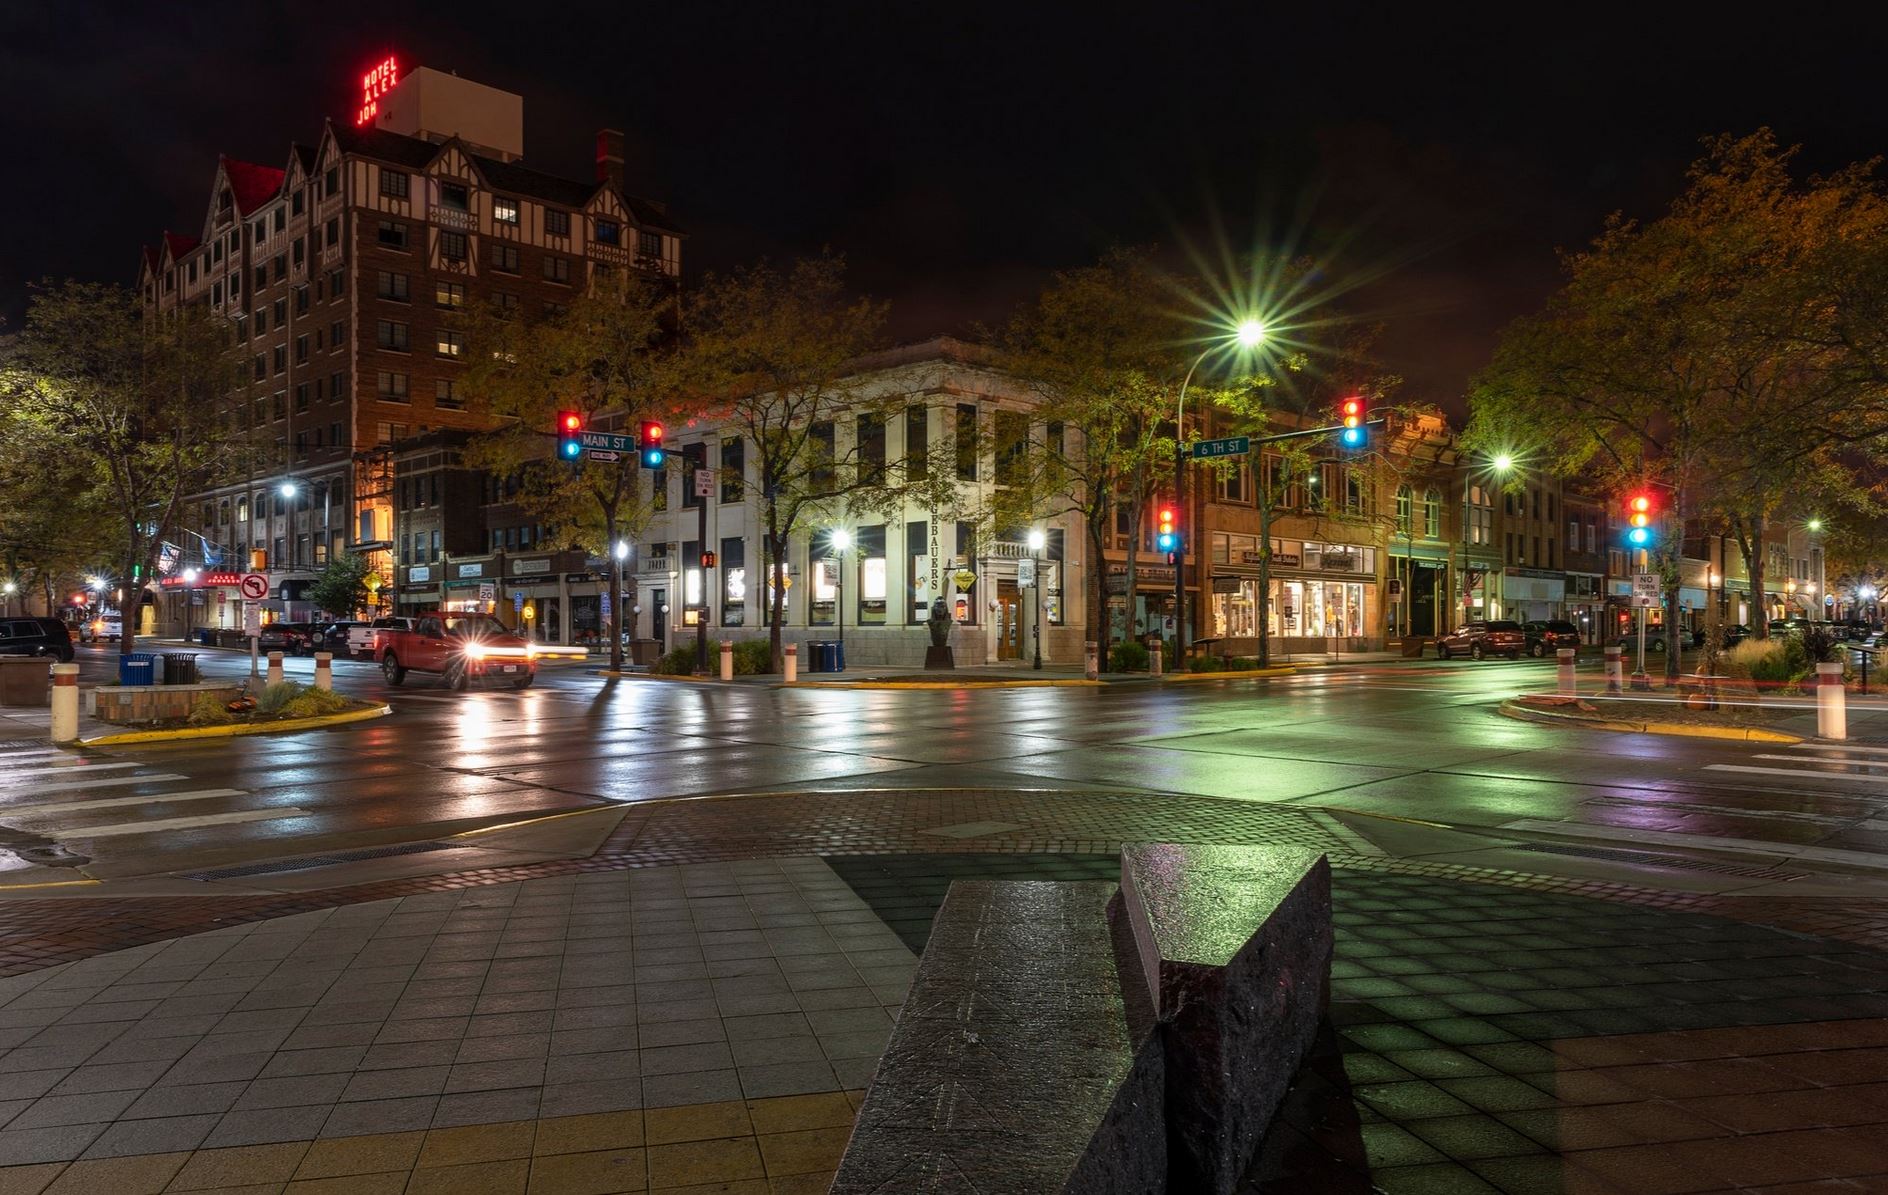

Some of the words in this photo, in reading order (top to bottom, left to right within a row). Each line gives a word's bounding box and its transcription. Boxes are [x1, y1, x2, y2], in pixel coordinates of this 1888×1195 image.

[363, 56, 397, 91] HOTEL
[364, 72, 397, 104] ALEX
[582, 434, 609, 448] MAIN
[613, 437, 626, 449] ST
[1201, 444, 1208, 455] 6
[1212, 442, 1224, 454] TH
[1228, 440, 1240, 452] ST
[930, 503, 939, 590] GEBAUERS
[480, 591, 493, 599] 20
